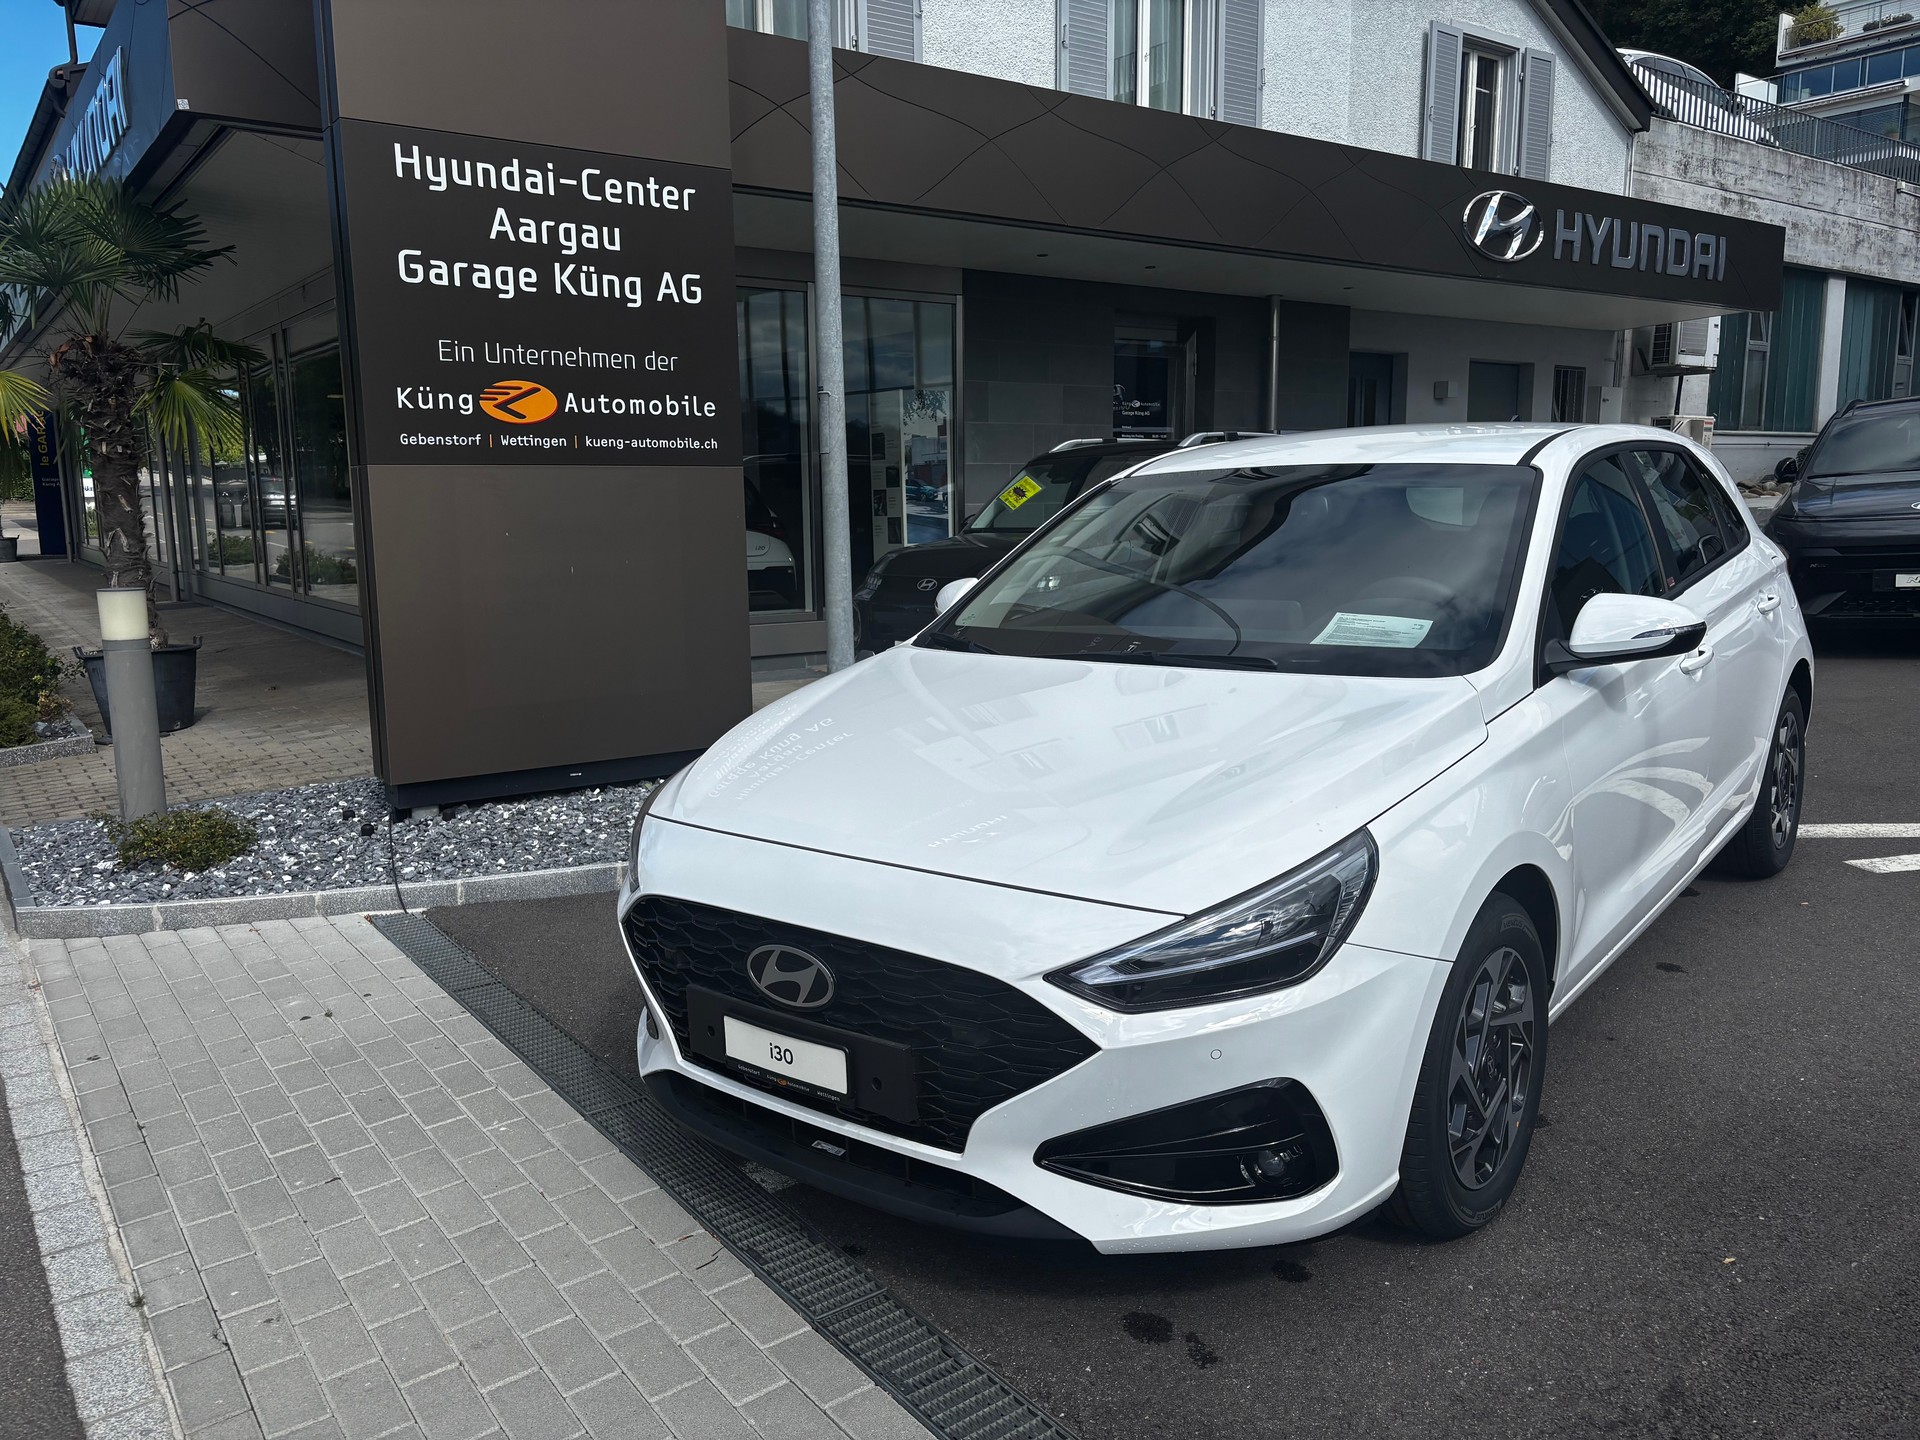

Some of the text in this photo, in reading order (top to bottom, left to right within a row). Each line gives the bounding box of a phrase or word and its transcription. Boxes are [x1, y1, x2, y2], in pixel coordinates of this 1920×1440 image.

[393, 142, 696, 212] Hyundai-Center
[489, 207, 621, 256] Aargau
[1553, 208, 1727, 282] HYUNDAI
[397, 248, 704, 308] Garage Küng AG
[438, 339, 679, 372] Ein Unternehmen der
[396, 386, 717, 417] Küng Automobile
[399, 432, 718, 450] Gebenstorf Wettingen kueng-automobile.ch
[769, 1042, 794, 1065] i30
